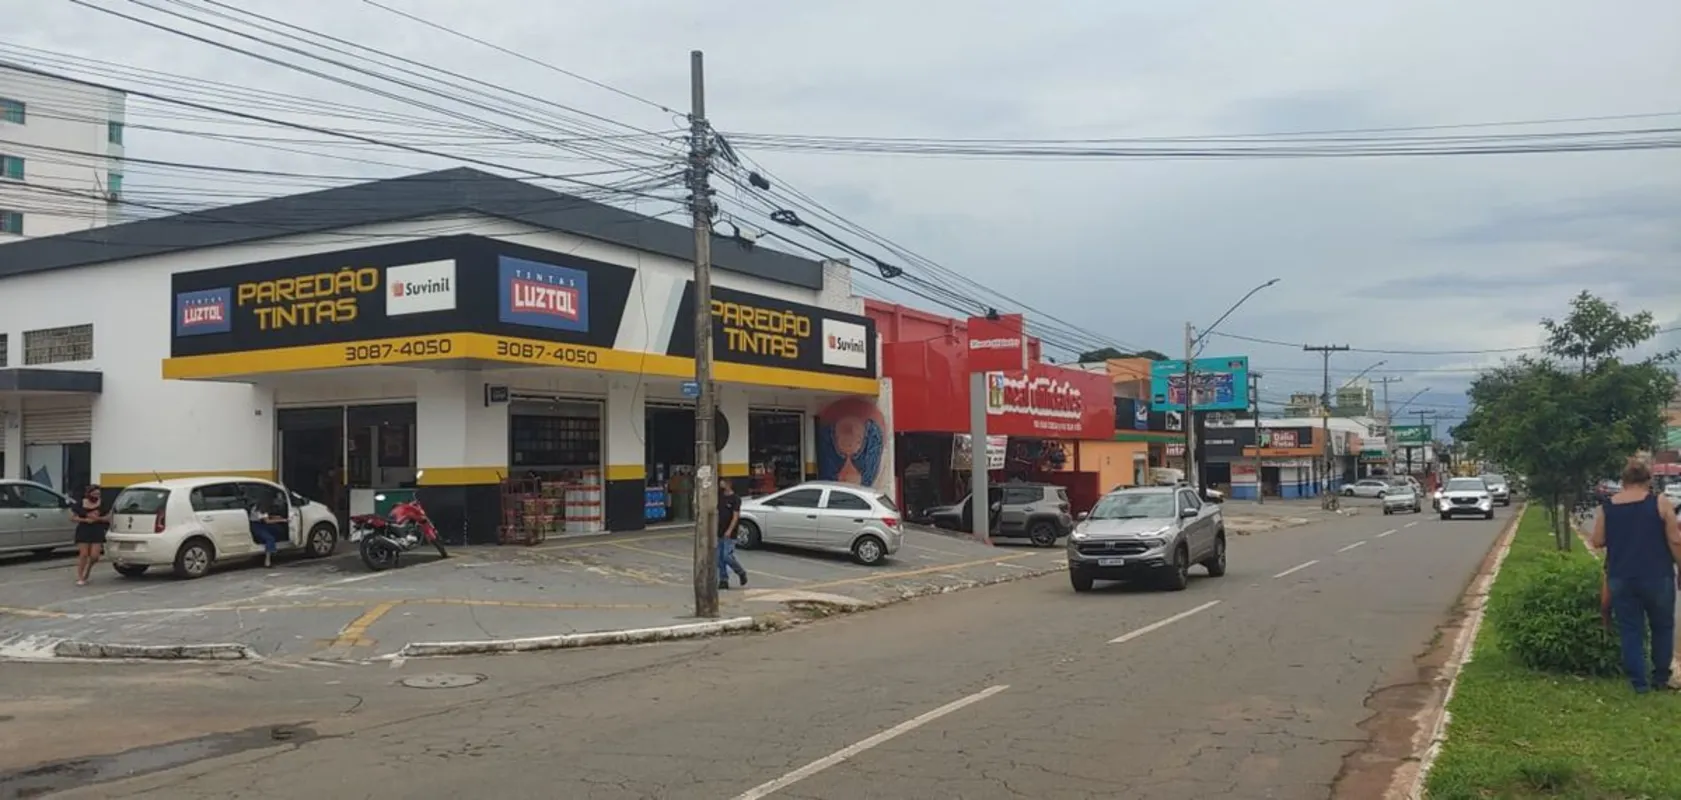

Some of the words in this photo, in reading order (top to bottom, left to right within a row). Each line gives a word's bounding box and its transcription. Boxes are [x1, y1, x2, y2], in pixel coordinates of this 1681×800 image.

[237, 267, 379, 306] PAREDÃO
[405, 277, 450, 297] Suvinil
[516, 269, 576, 287] TINTAS
[514, 282, 577, 316] LUZTOL
[183, 305, 223, 325] LUZTOL
[253, 297, 358, 330] TINTAS
[711, 299, 810, 337] PAREDÃO
[345, 338, 452, 362] 3087-4050
[496, 340, 598, 364] 3087-4050
[723, 327, 798, 359] TINTAS
[837, 336, 865, 354] Suvinil
